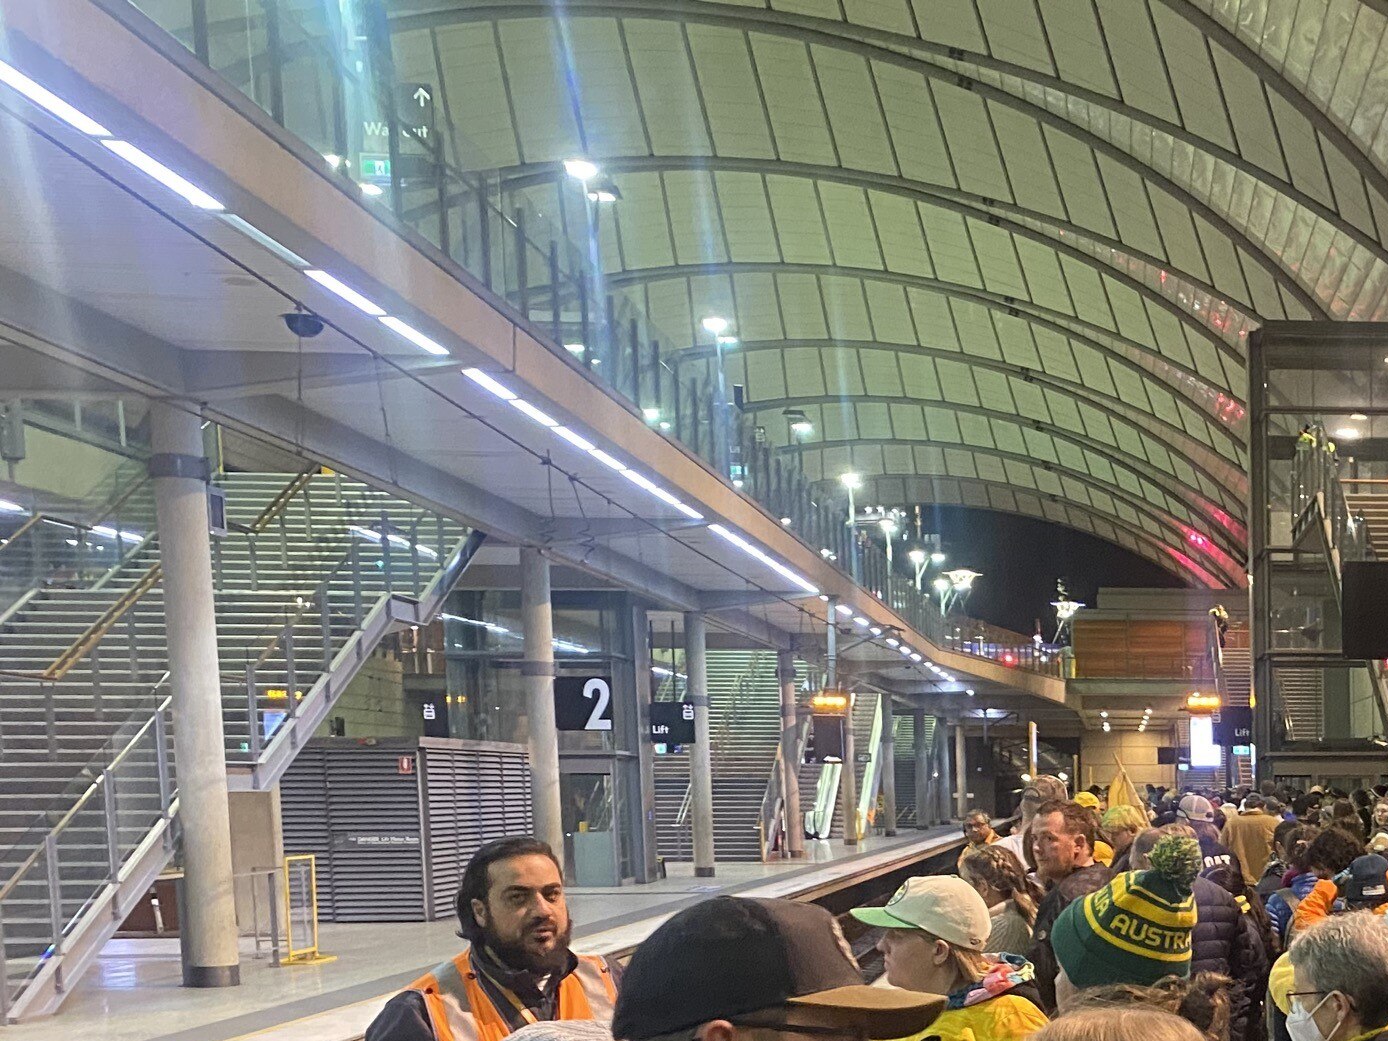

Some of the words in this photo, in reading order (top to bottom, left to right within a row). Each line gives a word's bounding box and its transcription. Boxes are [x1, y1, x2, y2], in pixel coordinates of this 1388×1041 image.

[363, 121, 389, 136] Wa
[582, 677, 612, 730] 2
[652, 724, 669, 735] Lift
